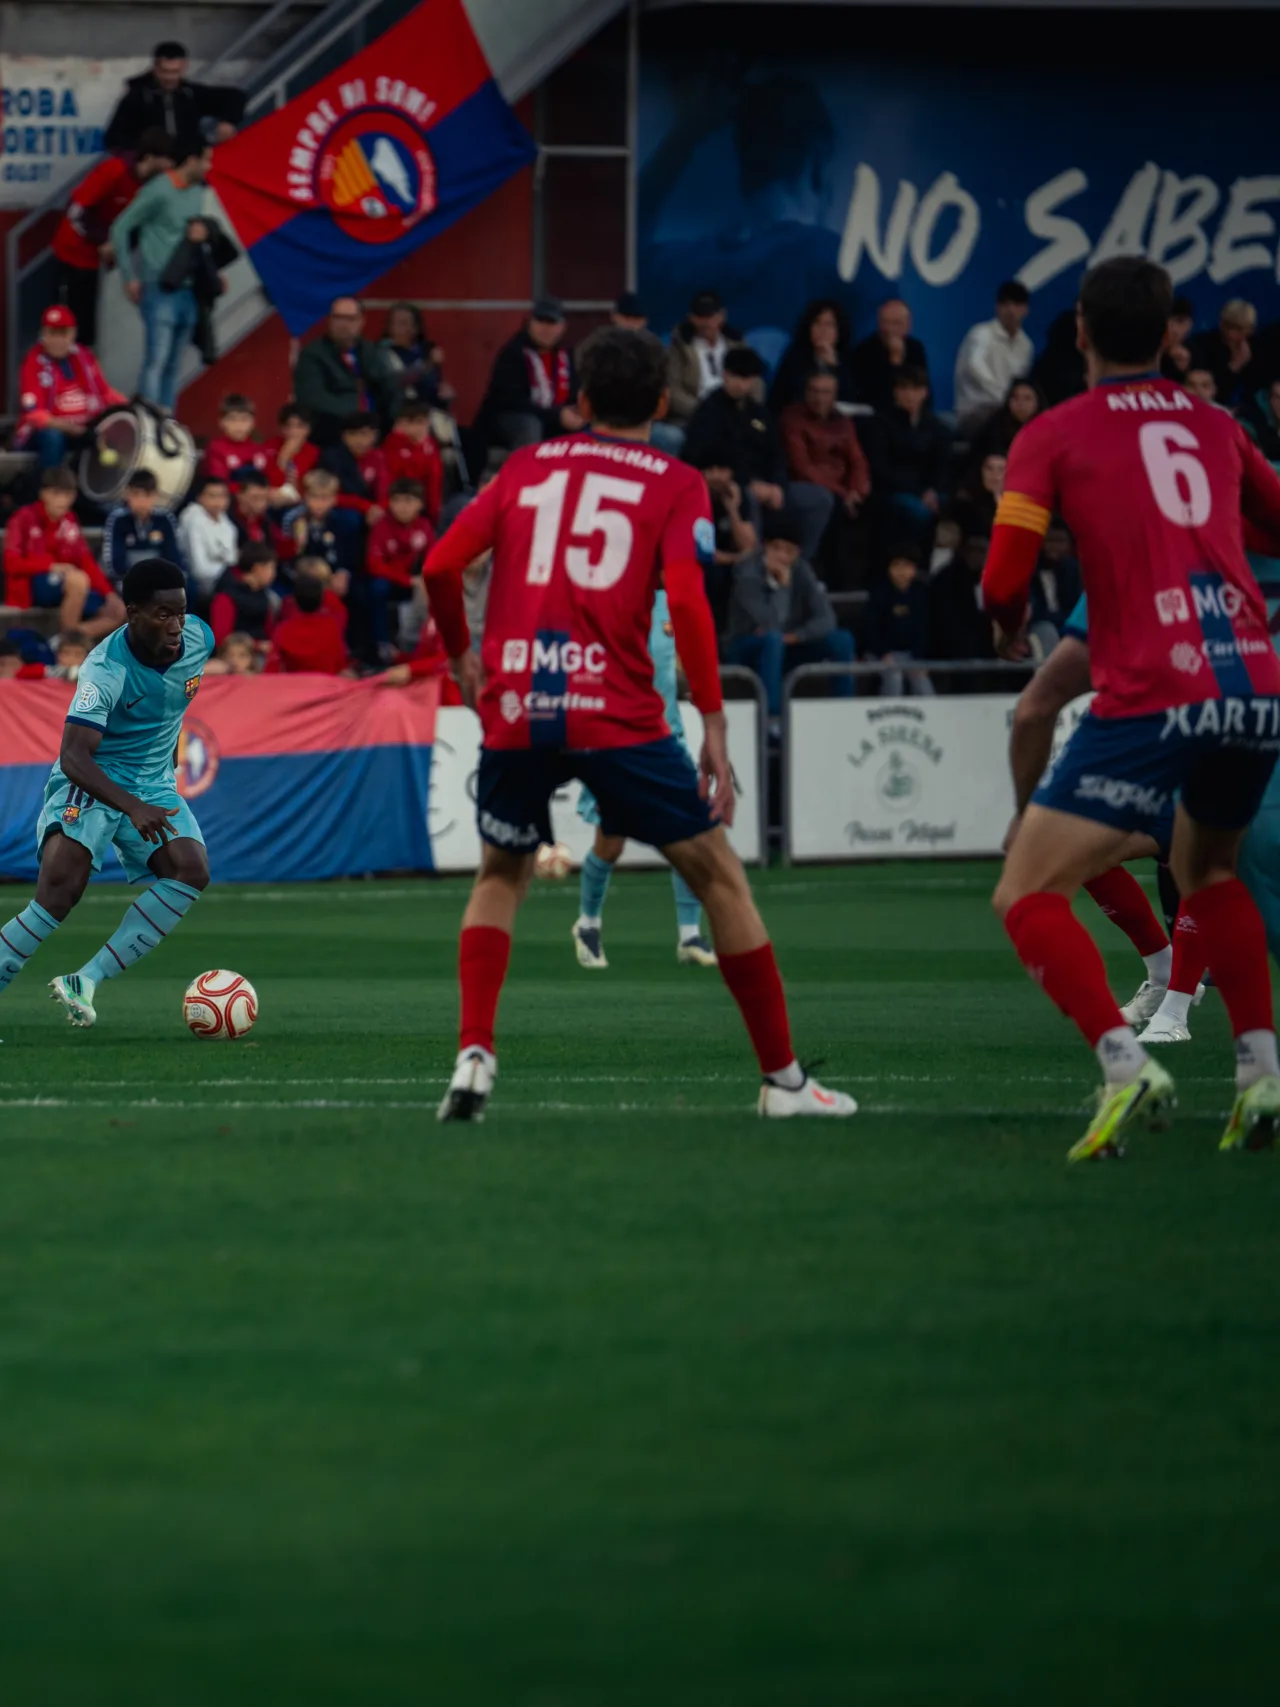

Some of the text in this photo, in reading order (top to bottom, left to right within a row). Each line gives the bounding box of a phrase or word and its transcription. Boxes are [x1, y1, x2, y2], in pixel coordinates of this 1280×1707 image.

[837, 160, 1280, 294] NO SABE
[1107, 389, 1195, 413] AYALA
[1137, 420, 1213, 529] 6
[516, 468, 647, 592] 15
[531, 638, 608, 674] MGC
